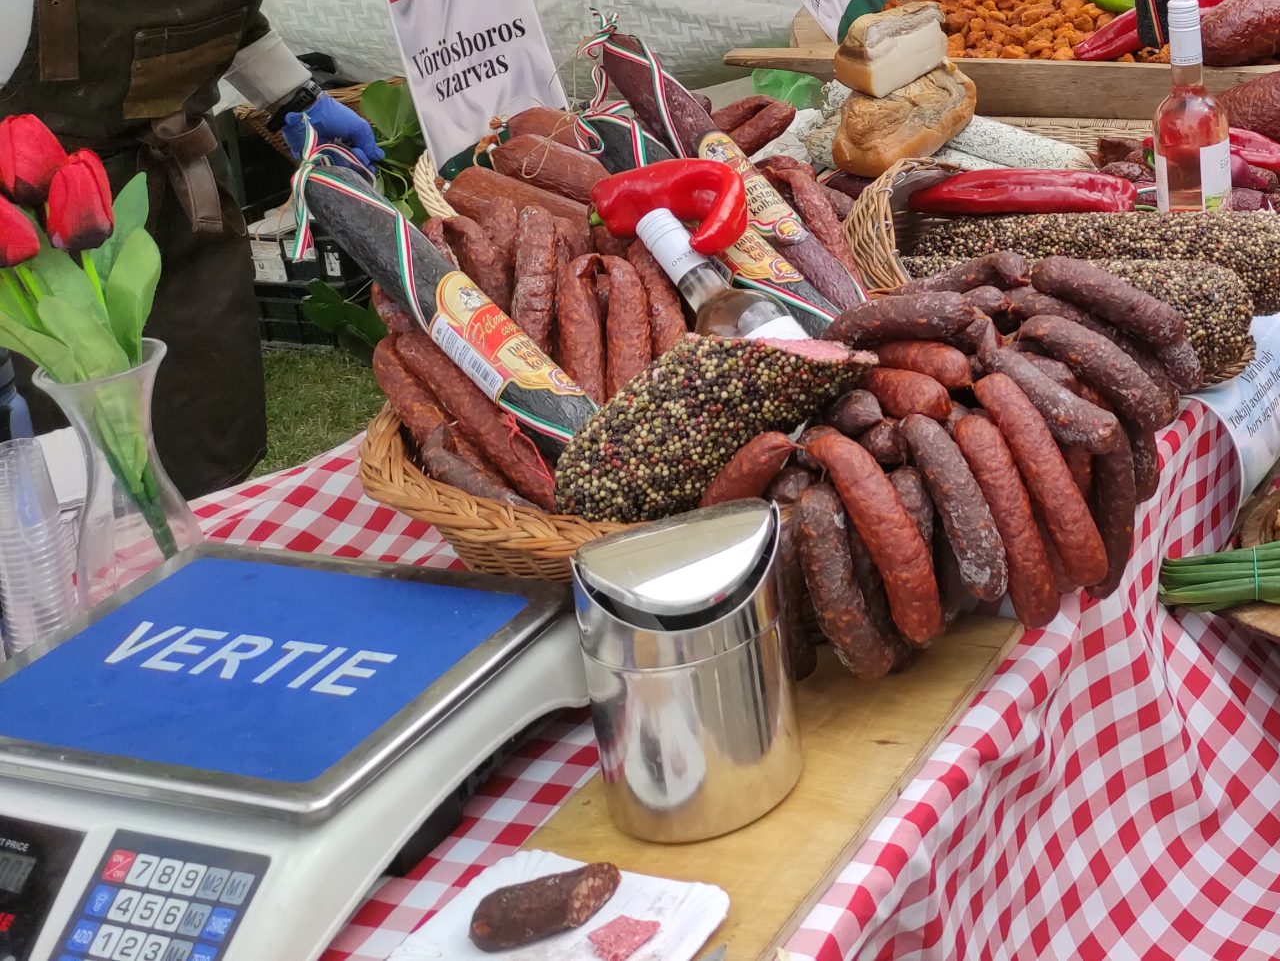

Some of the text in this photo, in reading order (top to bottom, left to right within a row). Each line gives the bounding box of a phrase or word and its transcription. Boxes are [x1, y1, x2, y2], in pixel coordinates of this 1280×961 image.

[412, 18, 526, 79] Vörösboros
[436, 54, 509, 102] szarvas
[103, 621, 398, 696] VERTIE
[5, 839, 30, 852] PRICE
[135, 860, 248, 897] 7 8 9 M2 M1
[116, 896, 133, 916] 4
[140, 900, 158, 920] 5
[163, 905, 181, 925] 6
[184, 910, 205, 929] M3
[72, 929, 93, 945] ADD
[102, 932, 113, 951] 1
[119, 936, 138, 957] 2
[144, 941, 162, 961] 3
